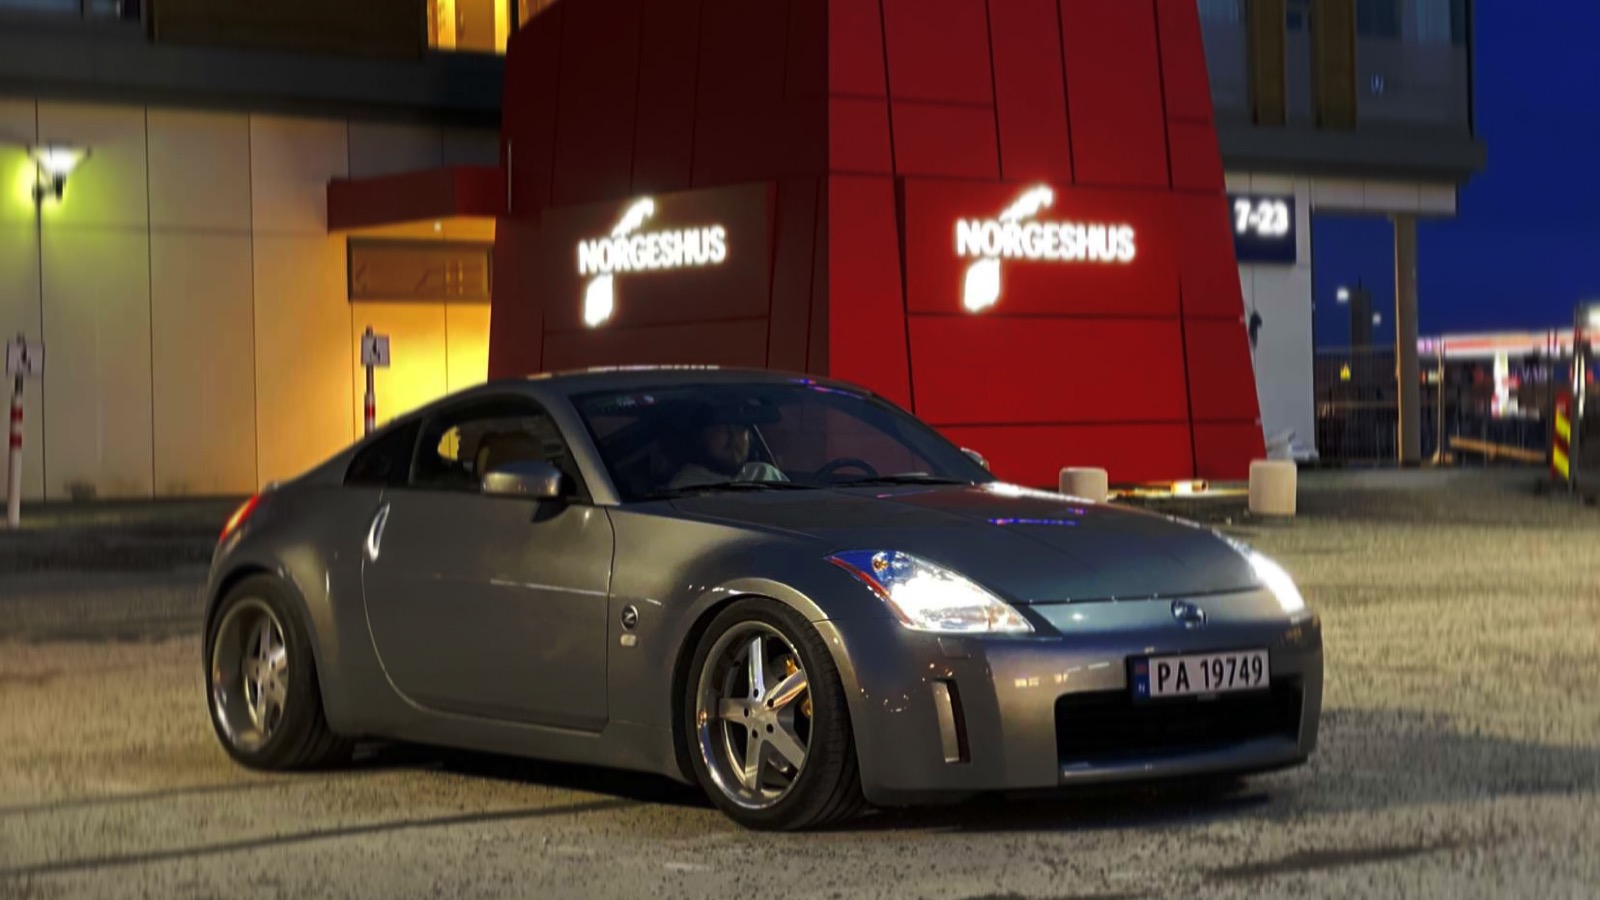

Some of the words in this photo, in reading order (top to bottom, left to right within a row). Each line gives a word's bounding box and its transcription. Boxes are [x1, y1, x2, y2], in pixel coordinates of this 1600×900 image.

[1234, 198, 1288, 236] 7-23
[578, 224, 727, 275] NORGESHUS
[956, 219, 1136, 264] NORGESHUS
[1158, 660, 1190, 692] PA
[1200, 654, 1263, 689] 19749
